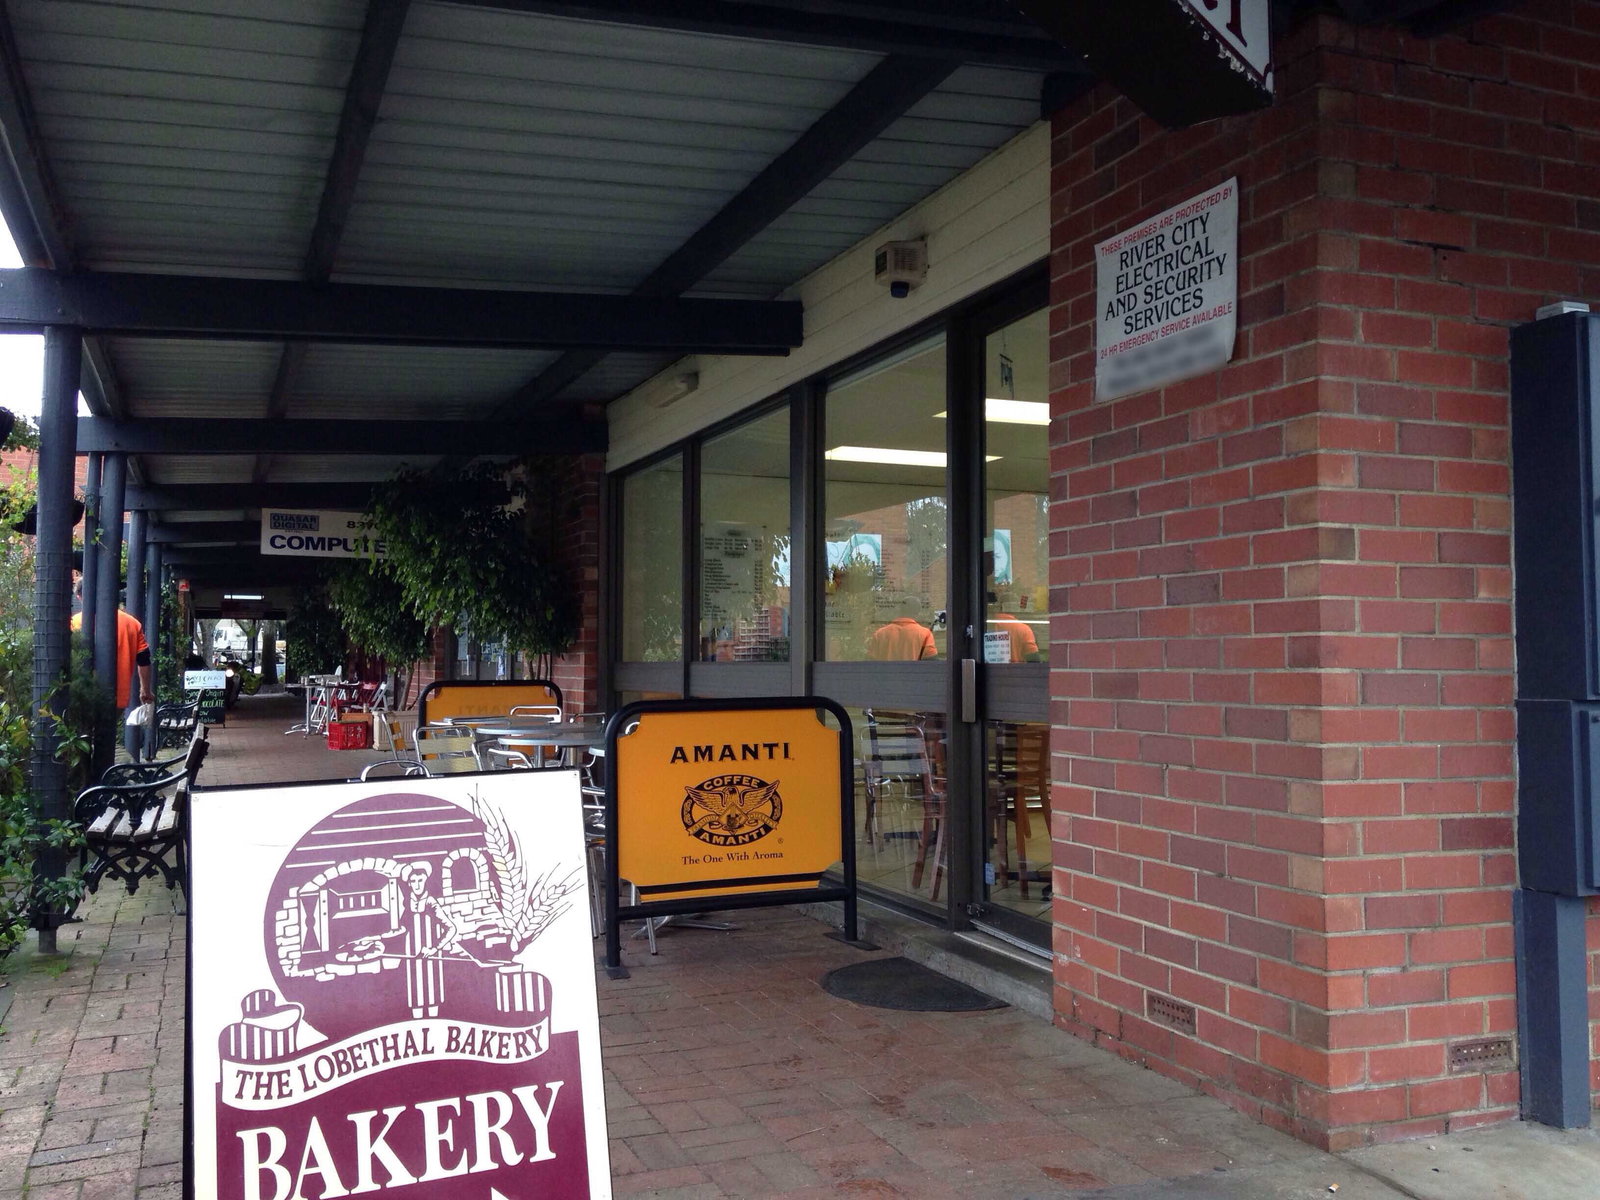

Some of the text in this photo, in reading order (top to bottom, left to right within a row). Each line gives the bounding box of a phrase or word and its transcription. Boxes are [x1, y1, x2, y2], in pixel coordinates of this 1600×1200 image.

[1101, 186, 1233, 257] THESE PREMISES ARE PROTECTED BY
[1119, 212, 1210, 271] RIVER CITY
[1105, 253, 1227, 321] AND SECURITY
[1116, 236, 1214, 295] ELECTRICAL
[1100, 302, 1233, 360] 24 HR EMERGENCY SERVICE AVAILABLE
[1124, 288, 1203, 335] SERVICES
[670, 742, 790, 764] AMANTI
[703, 776, 759, 790] COFFEE
[682, 850, 784, 866] The One With Aroma
[700, 827, 767, 846] AMANTI
[235, 1025, 544, 1102] THE LOBETHAL BAKERY
[236, 1080, 565, 1200] BAKERY
